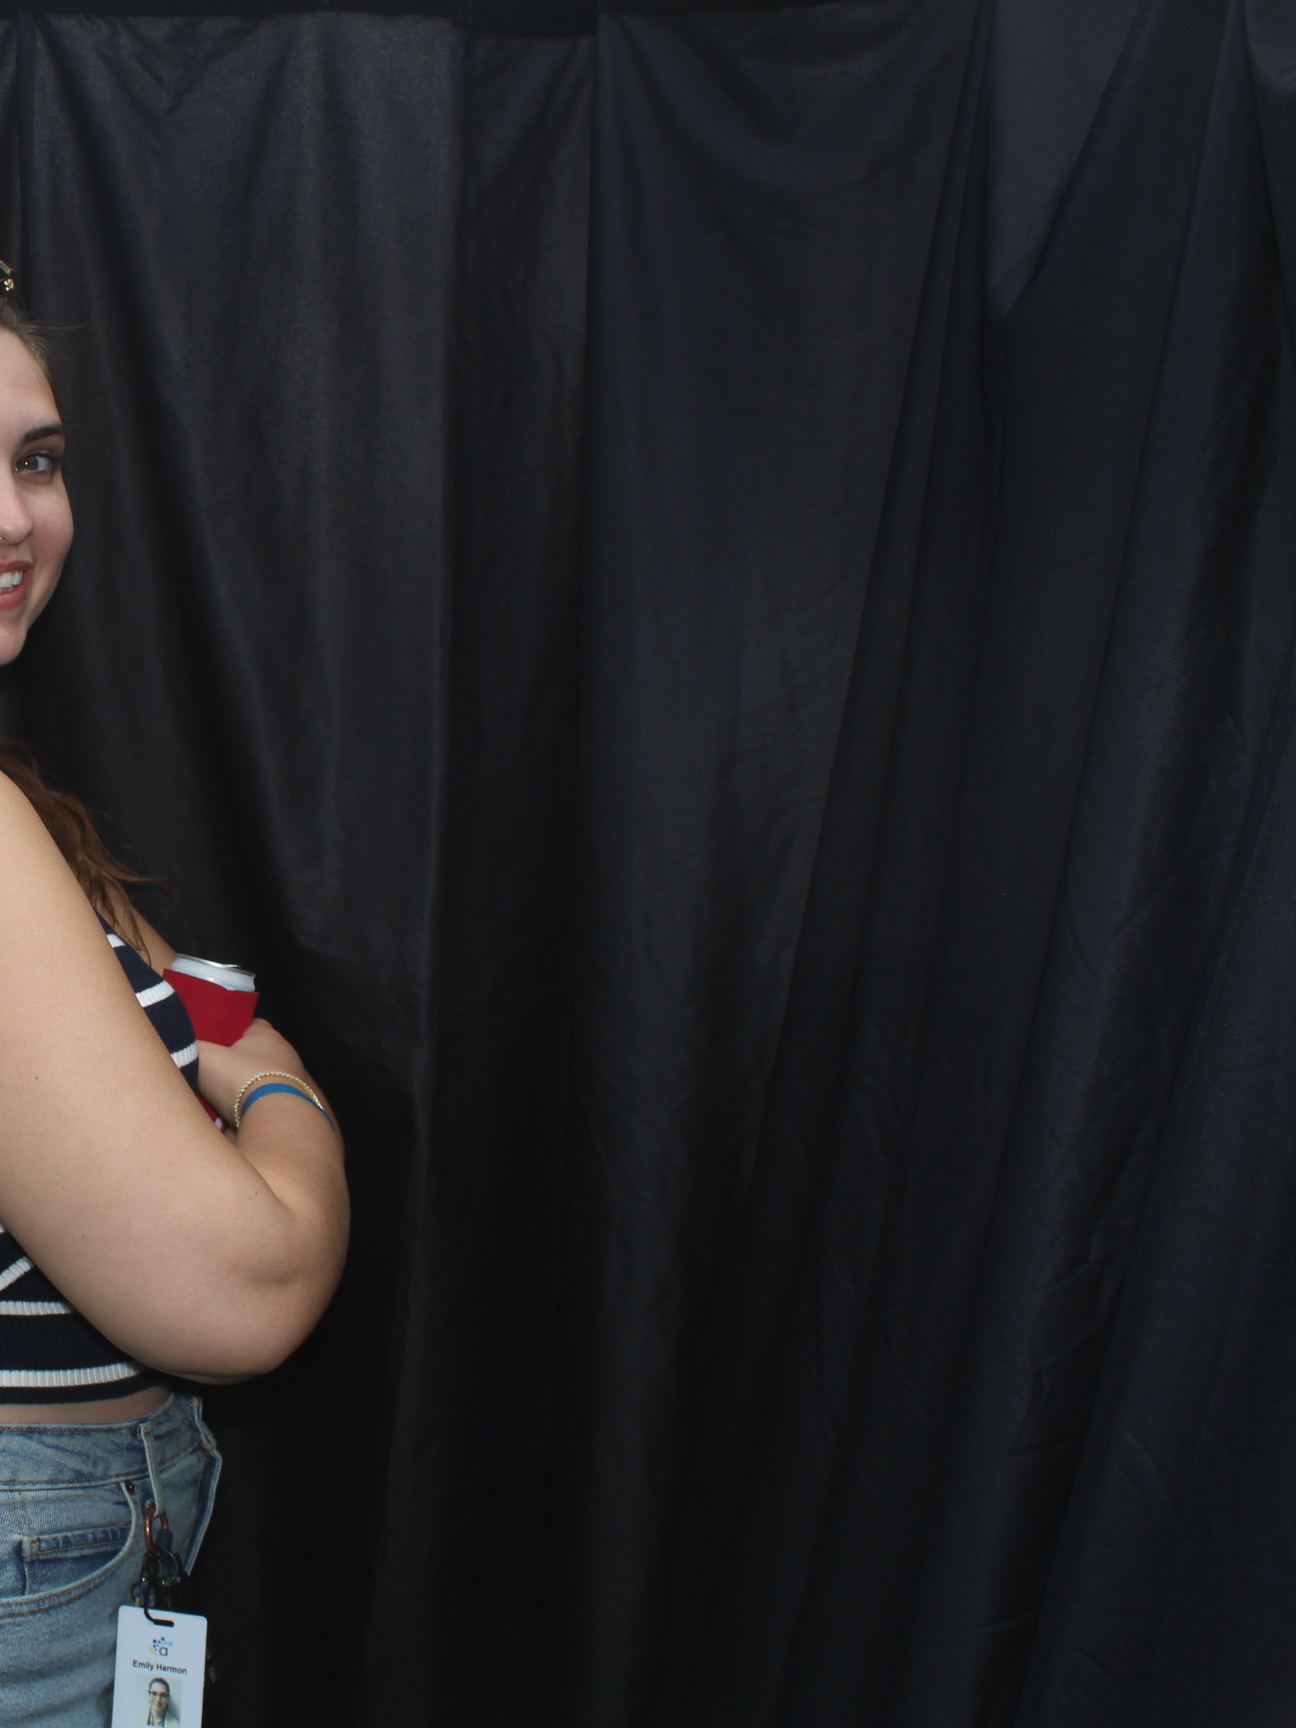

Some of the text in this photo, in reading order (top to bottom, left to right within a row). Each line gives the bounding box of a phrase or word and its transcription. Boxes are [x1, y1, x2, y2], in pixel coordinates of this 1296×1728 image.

[159, 1647, 168, 1656] a
[133, 1660, 187, 1674] Emily Harmon
